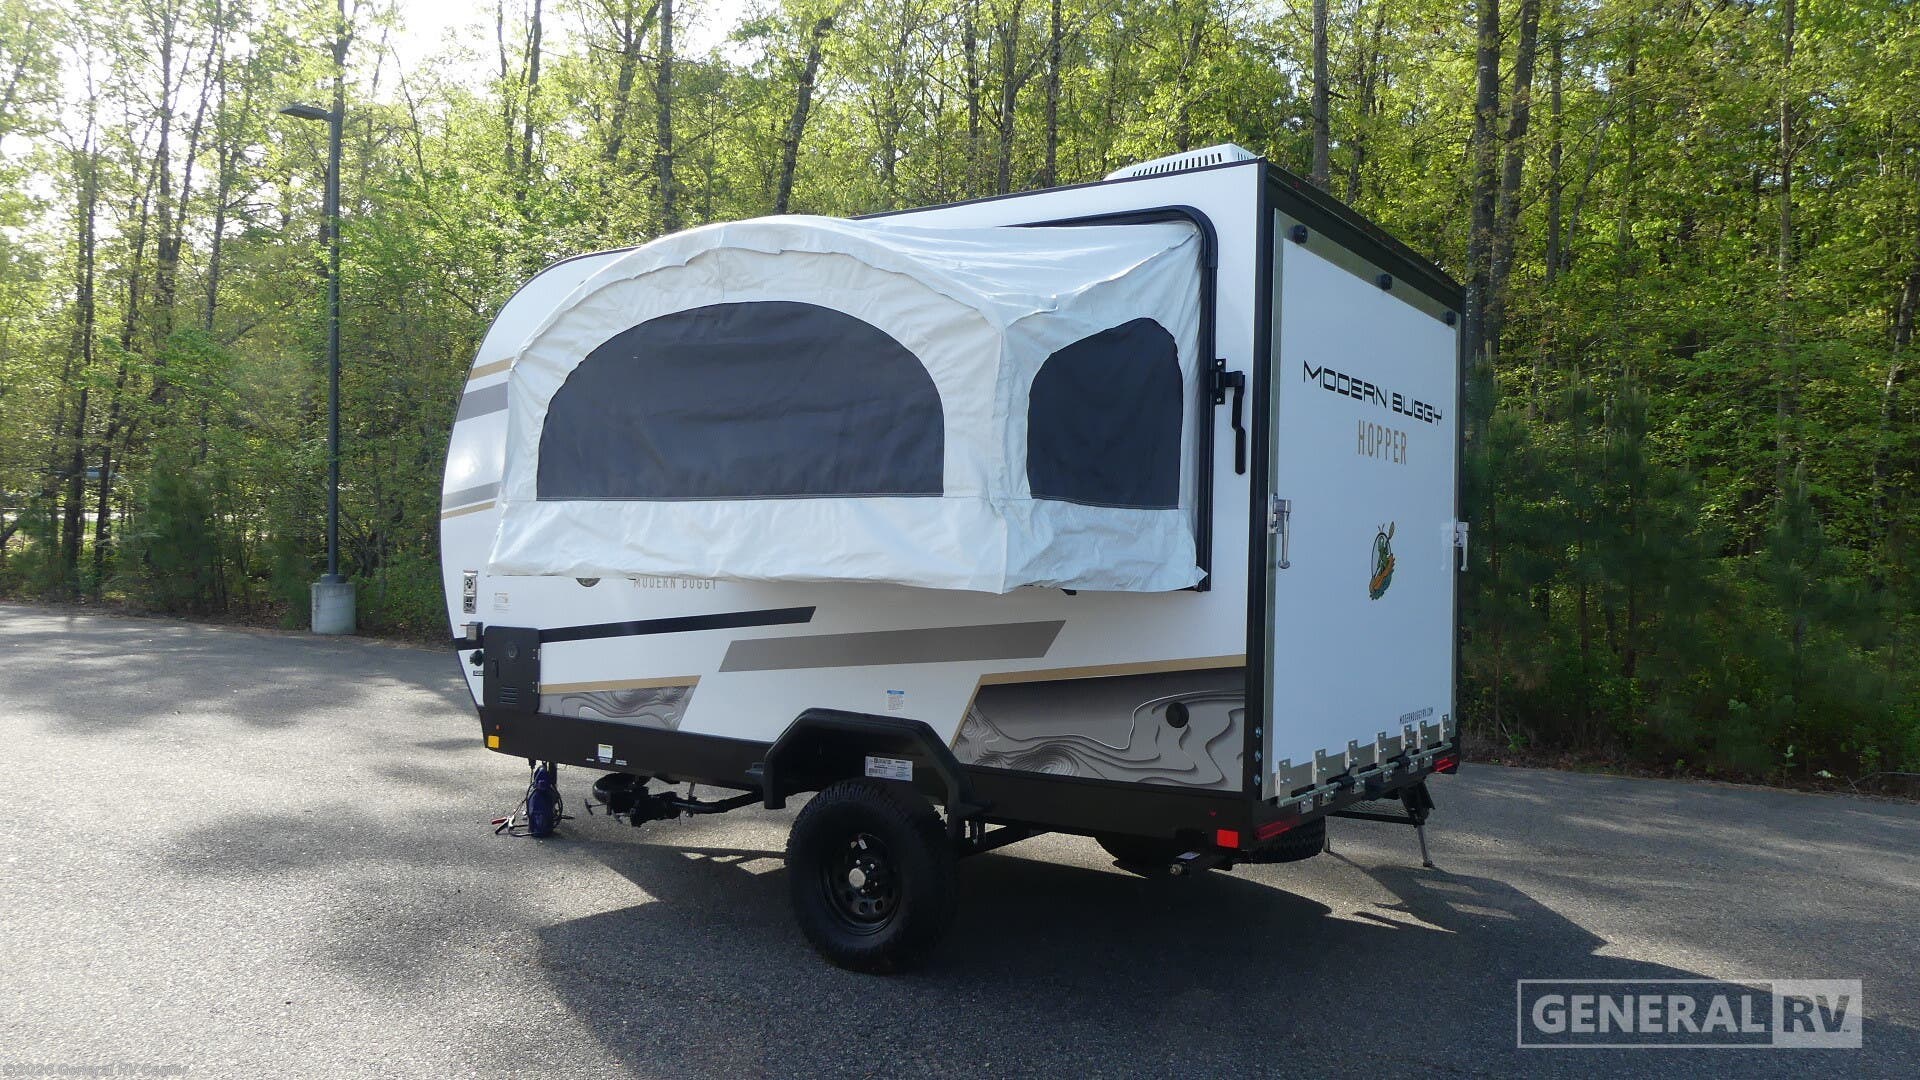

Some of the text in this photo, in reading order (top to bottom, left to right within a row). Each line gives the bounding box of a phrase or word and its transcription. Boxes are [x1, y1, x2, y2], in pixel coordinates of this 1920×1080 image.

[1303, 359, 1442, 427] MODERN BUGGY
[1358, 419, 1407, 465] HOPPER
